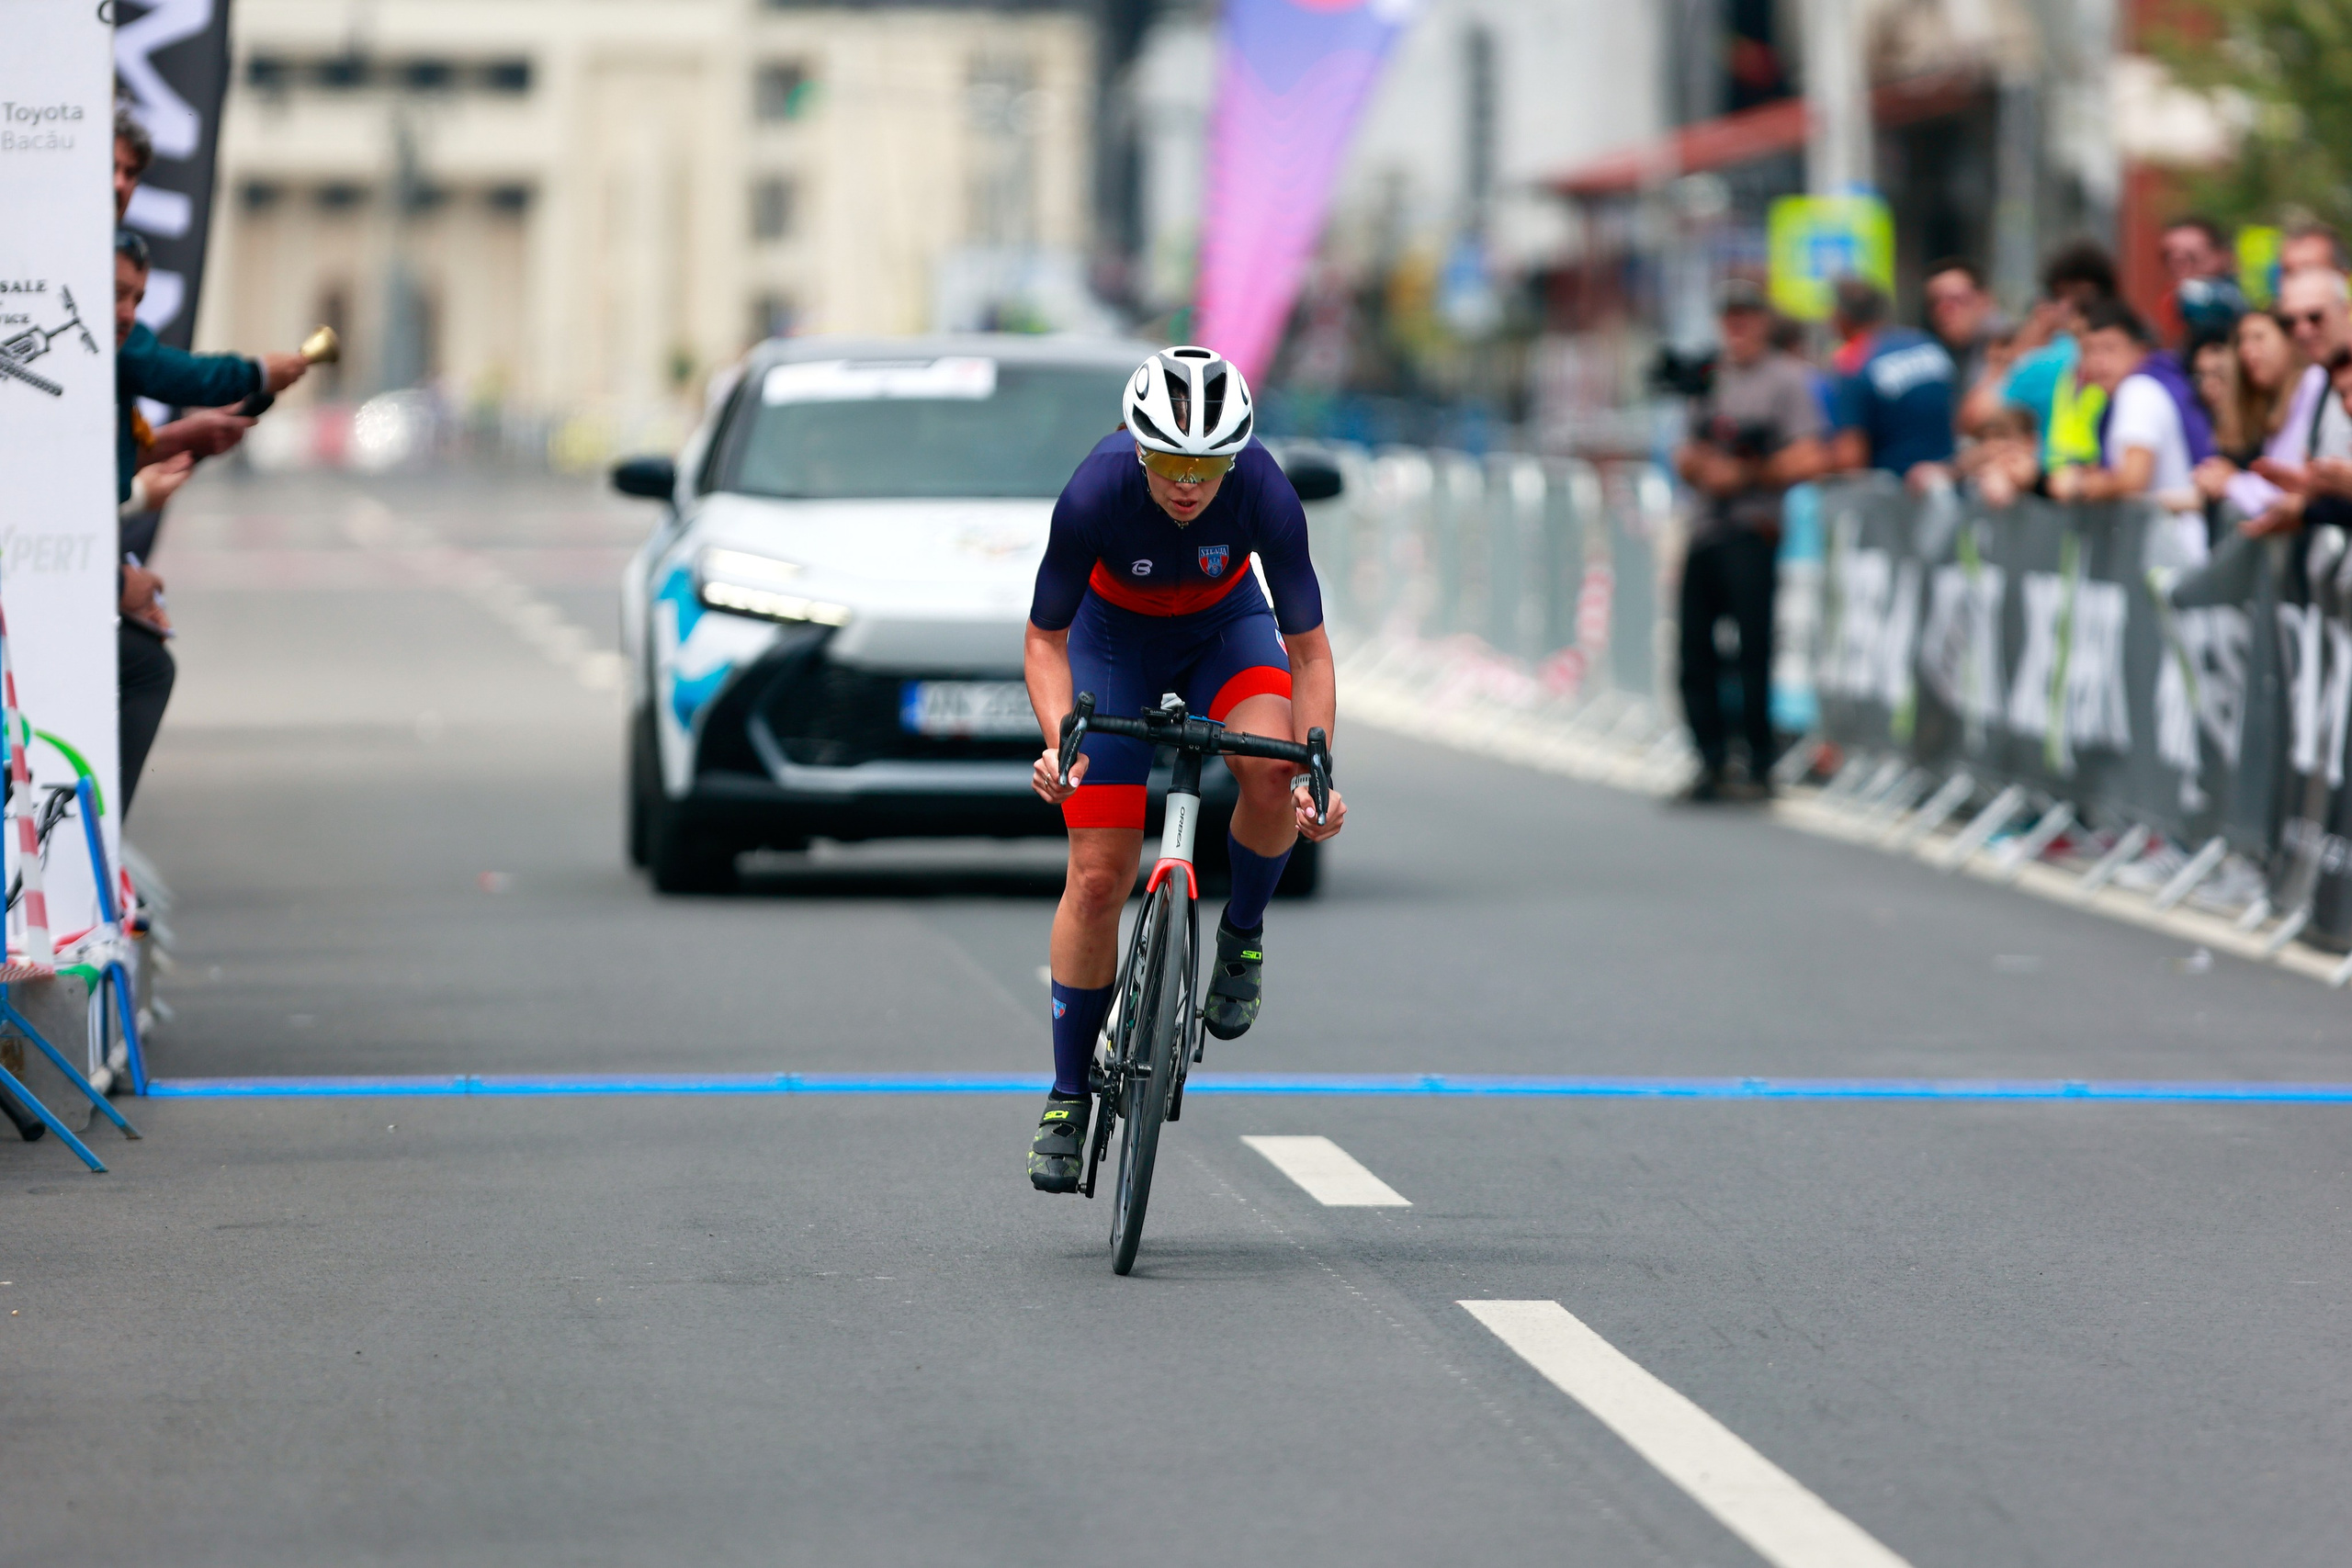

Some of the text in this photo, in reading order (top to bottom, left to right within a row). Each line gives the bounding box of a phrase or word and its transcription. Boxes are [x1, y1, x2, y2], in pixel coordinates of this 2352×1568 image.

[3, 101, 84, 126] Toyota
[2, 130, 74, 149] Bacău
[1175, 806, 1186, 849] ORBEA
